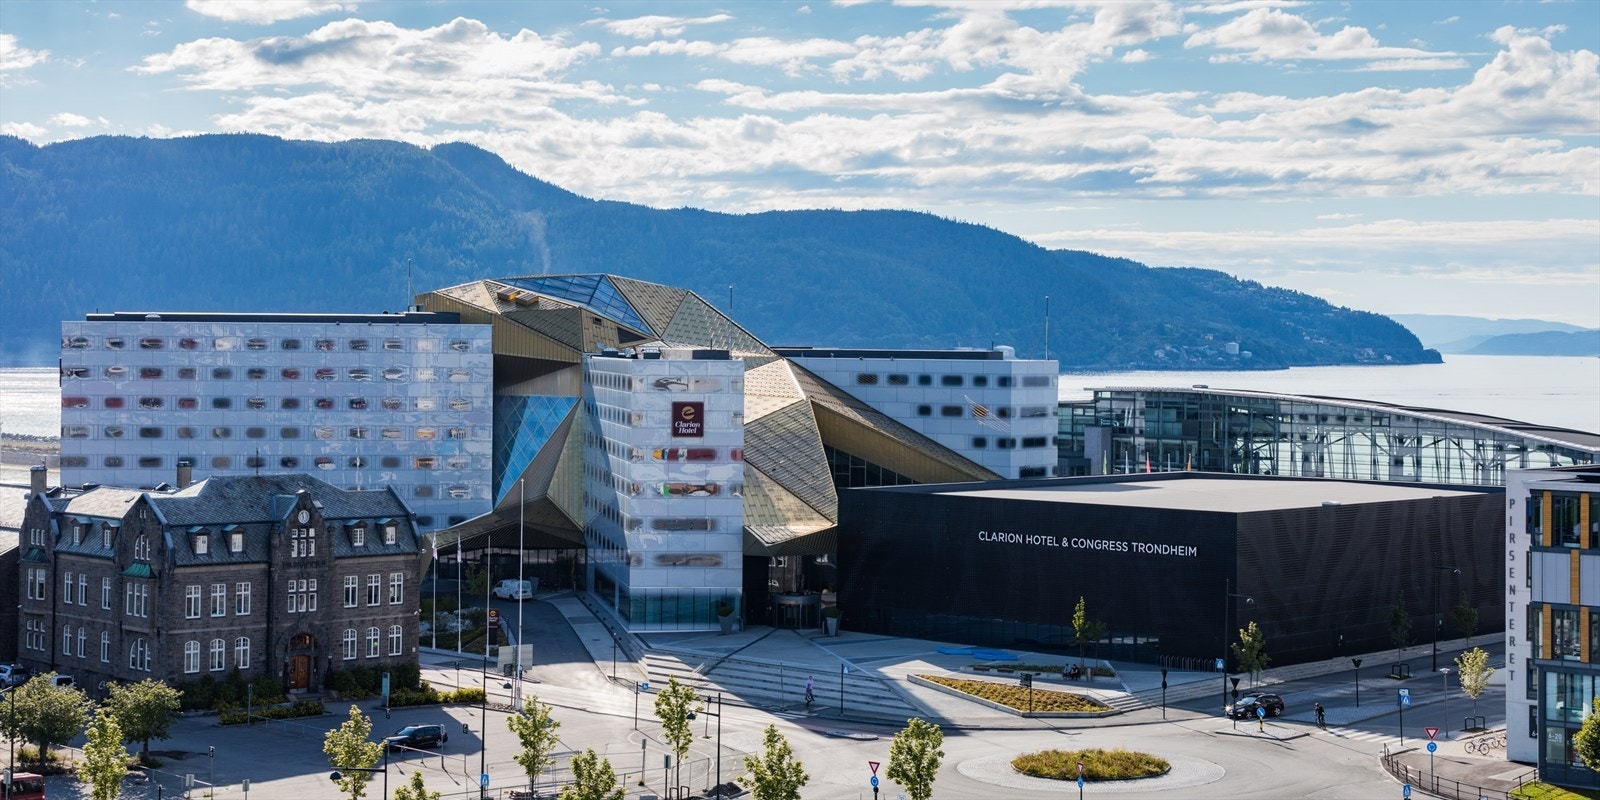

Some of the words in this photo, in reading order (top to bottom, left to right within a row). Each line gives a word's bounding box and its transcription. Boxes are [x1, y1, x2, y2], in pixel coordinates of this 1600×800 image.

[674, 420, 701, 428] Clarion
[978, 530, 1023, 544] CLARION
[1025, 533, 1059, 547] HOTEL
[1061, 536, 1069, 547] &
[1071, 537, 1129, 552] CONGRESS
[1131, 541, 1197, 557] TRONDHEIM
[1508, 498, 1516, 681] PIRSENTERET
